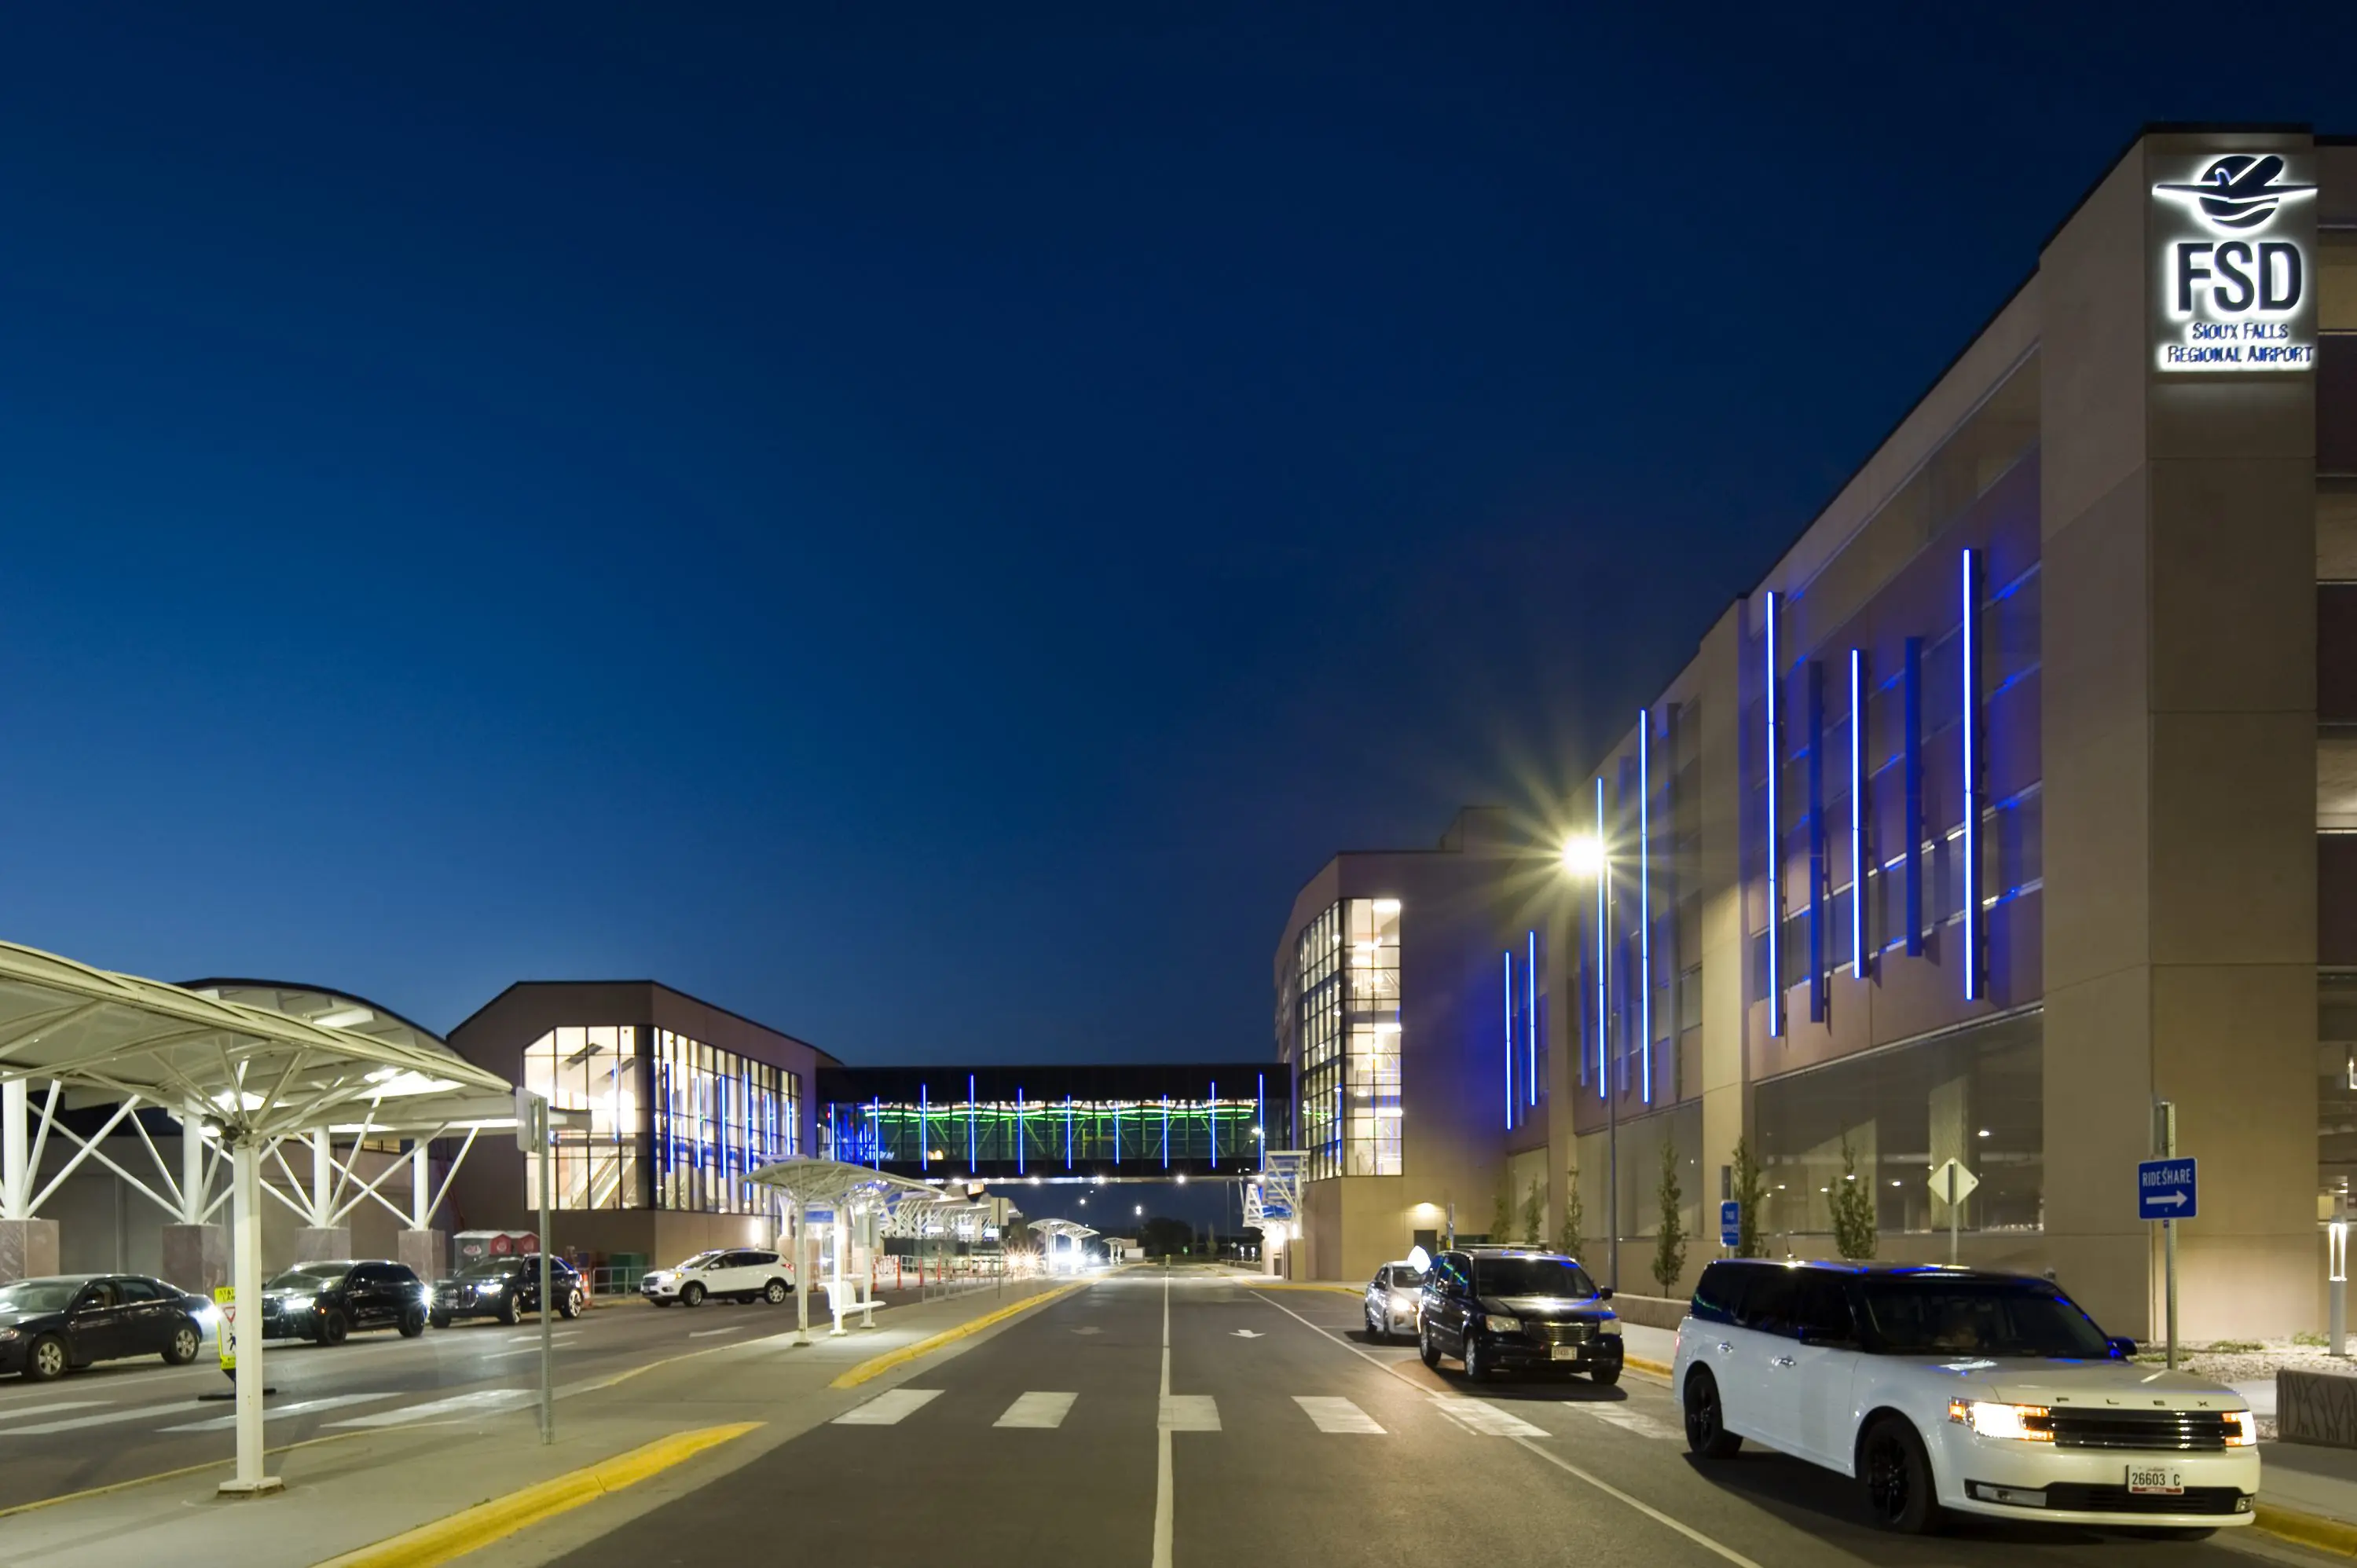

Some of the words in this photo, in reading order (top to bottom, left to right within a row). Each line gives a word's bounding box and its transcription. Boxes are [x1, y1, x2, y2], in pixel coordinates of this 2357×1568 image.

[2177, 241, 2302, 313] FSD
[2192, 322, 2238, 340] SIOUX
[2243, 322, 2289, 340] FALLS
[2167, 345, 2242, 363] REGIONAL
[2246, 345, 2314, 363] AIRPORT
[2143, 1167, 2192, 1187] RIDESHARE
[2055, 1397, 2209, 1407] FLEX
[2132, 1471, 2166, 1486] 26603
[2173, 1474, 2180, 1486] C
